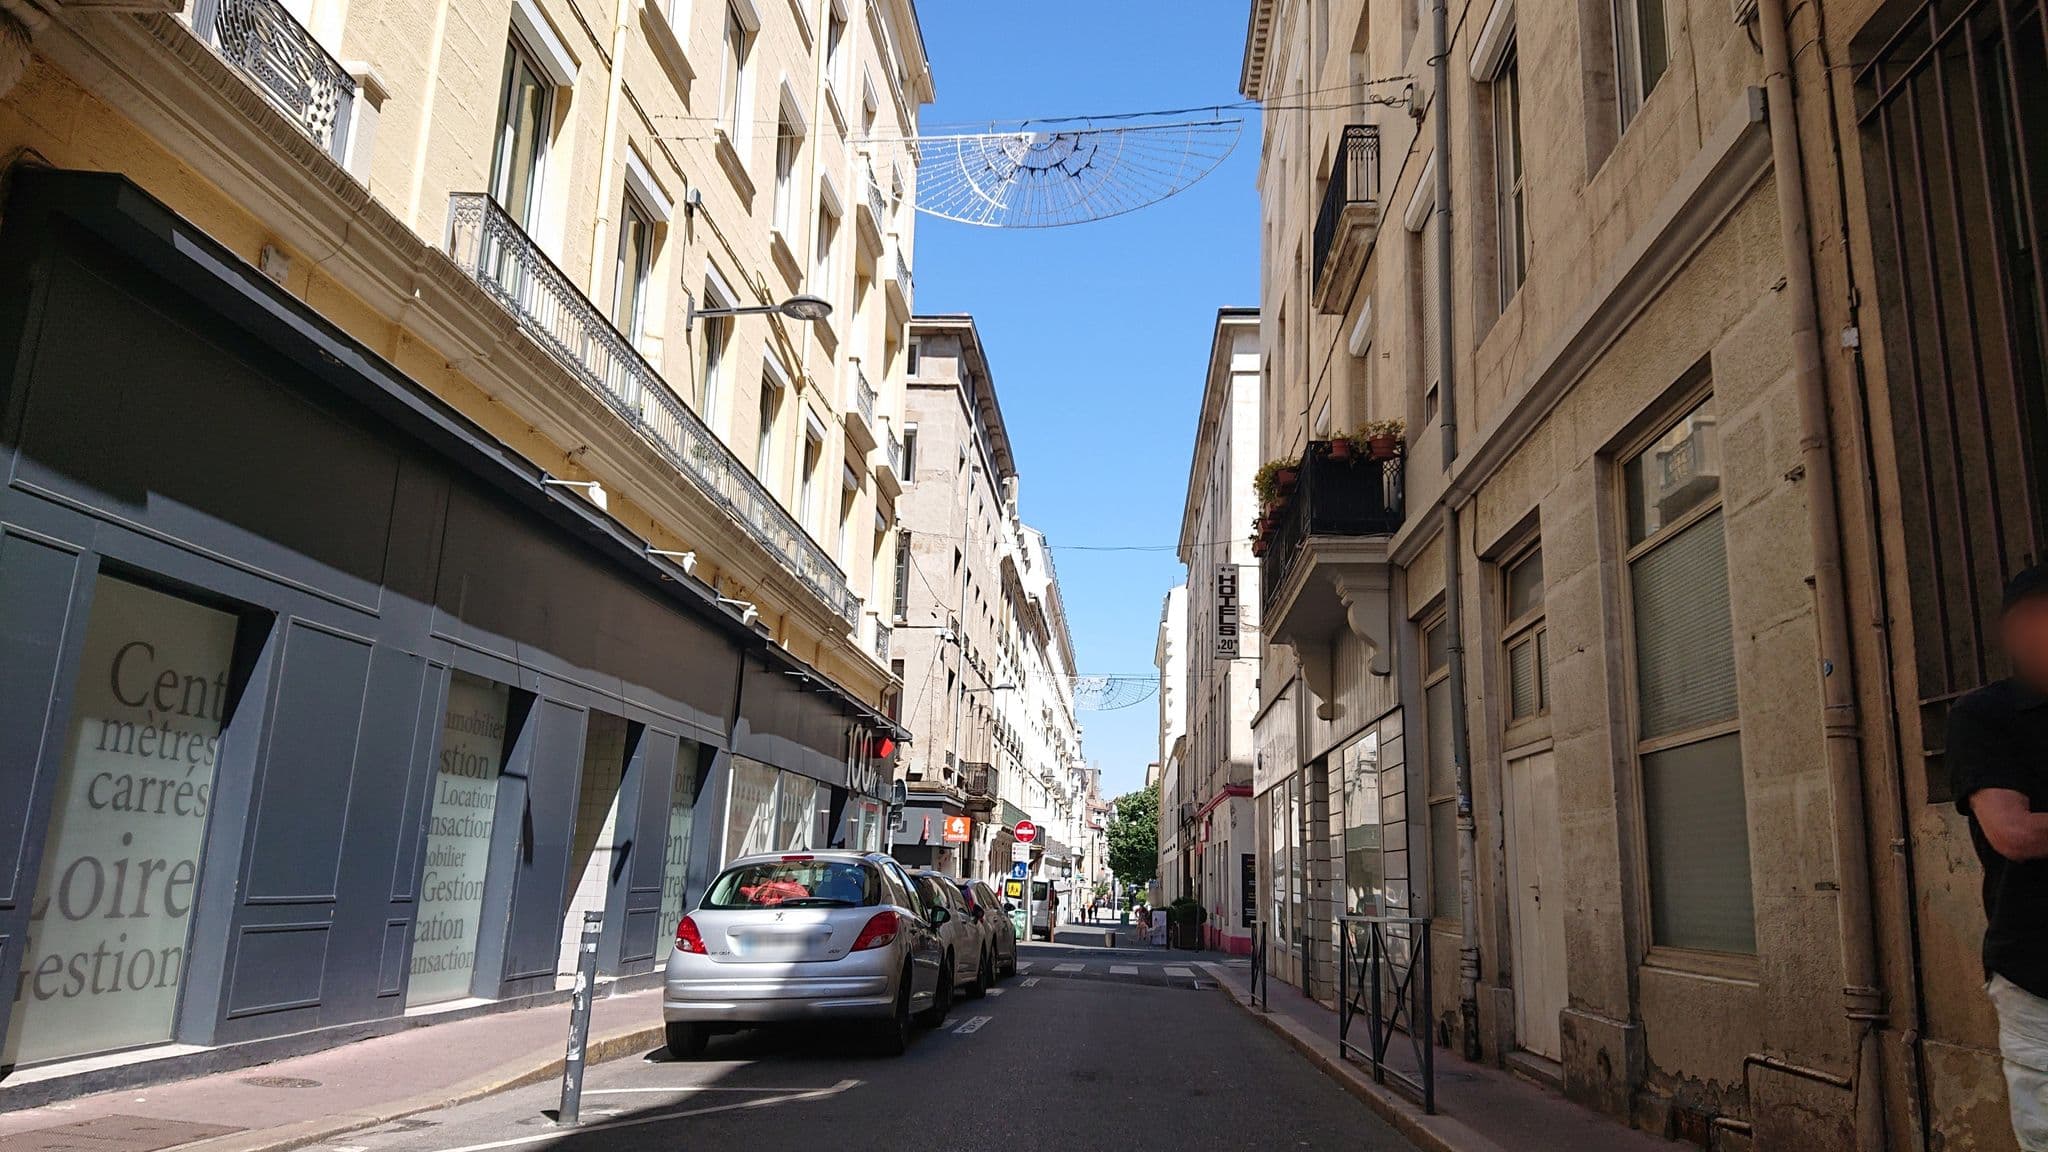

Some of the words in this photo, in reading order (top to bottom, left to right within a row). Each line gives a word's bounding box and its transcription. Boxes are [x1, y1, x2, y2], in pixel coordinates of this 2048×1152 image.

[1218, 574, 1236, 636] HOTELS
[111, 641, 227, 722] Cent
[96, 710, 218, 766] mètres
[440, 744, 489, 780] stion
[87, 766, 209, 818] carrés
[440, 780, 496, 810] Location
[31, 832, 196, 921] oire
[424, 845, 466, 868] obilier
[422, 870, 483, 902] Gestion
[14, 932, 184, 1001] estion
